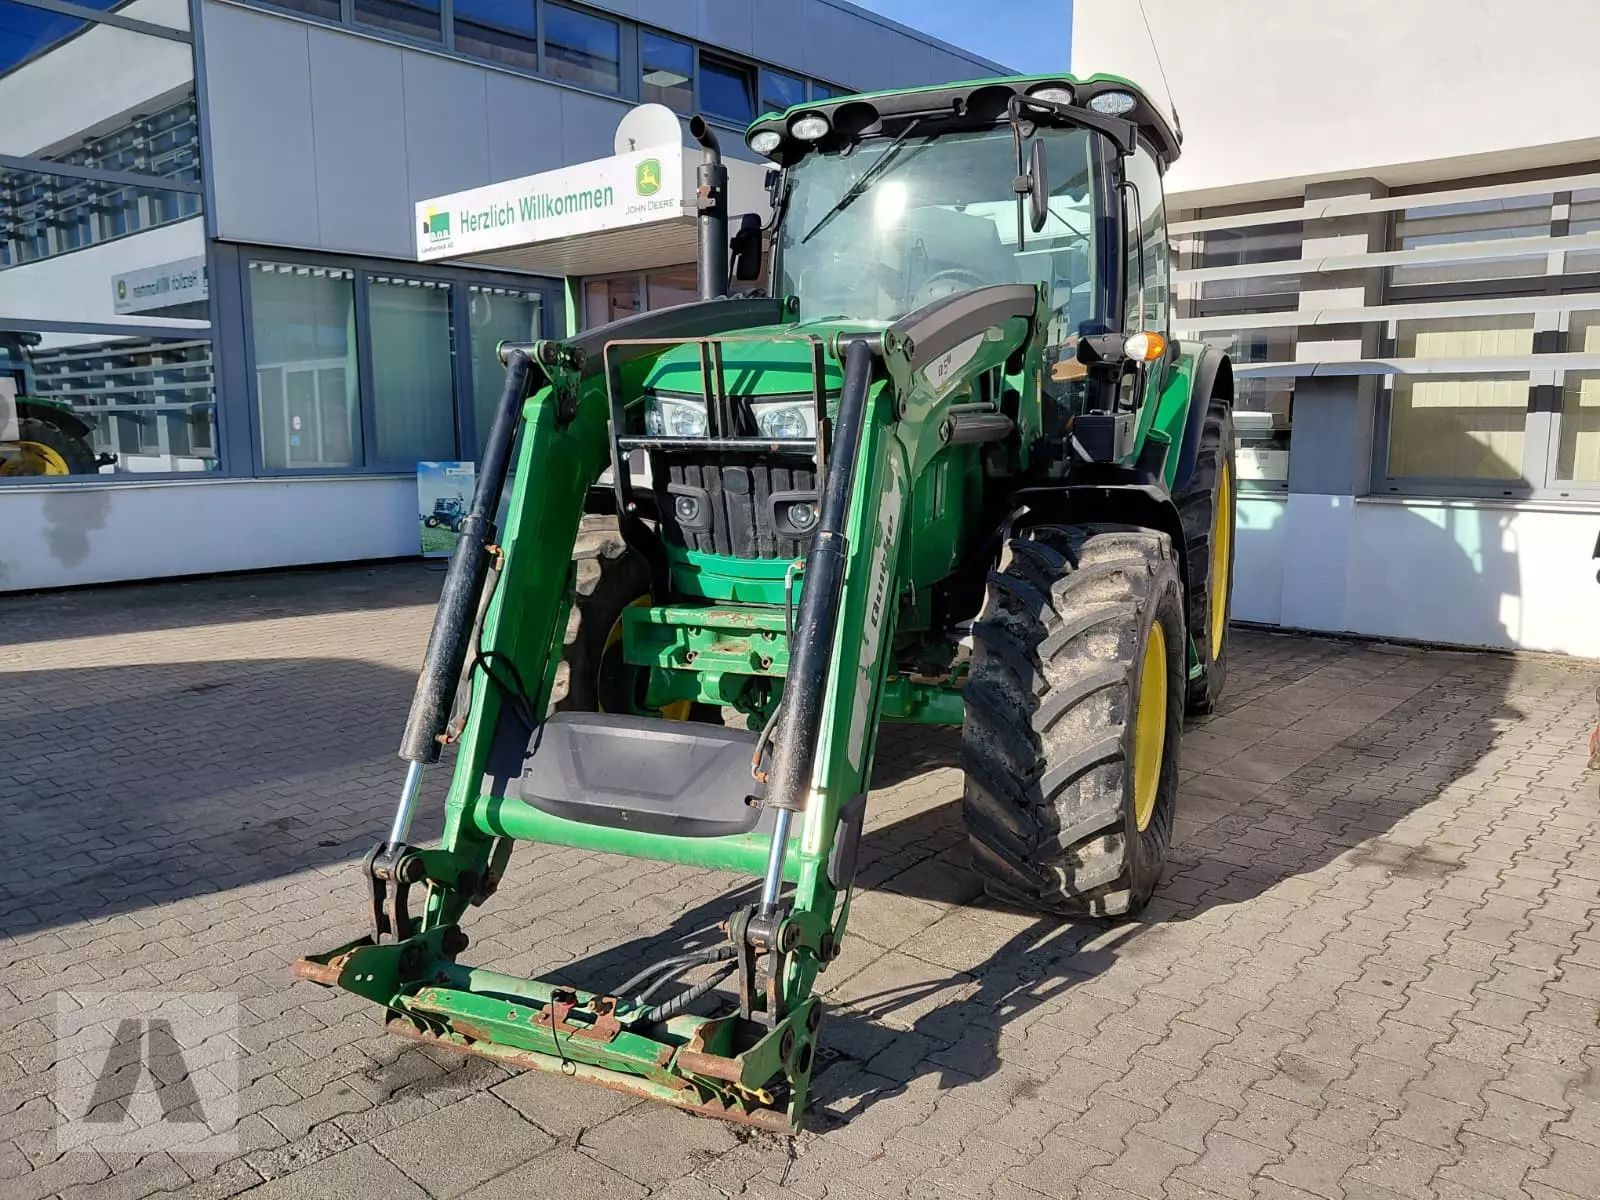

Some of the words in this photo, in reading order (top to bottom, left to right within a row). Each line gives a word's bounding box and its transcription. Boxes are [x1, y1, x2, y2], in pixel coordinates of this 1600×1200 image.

[460, 201, 514, 234] Herzlich
[518, 185, 614, 222] Willkommen
[625, 204, 646, 216] JOHN
[647, 198, 675, 211] DEERE
